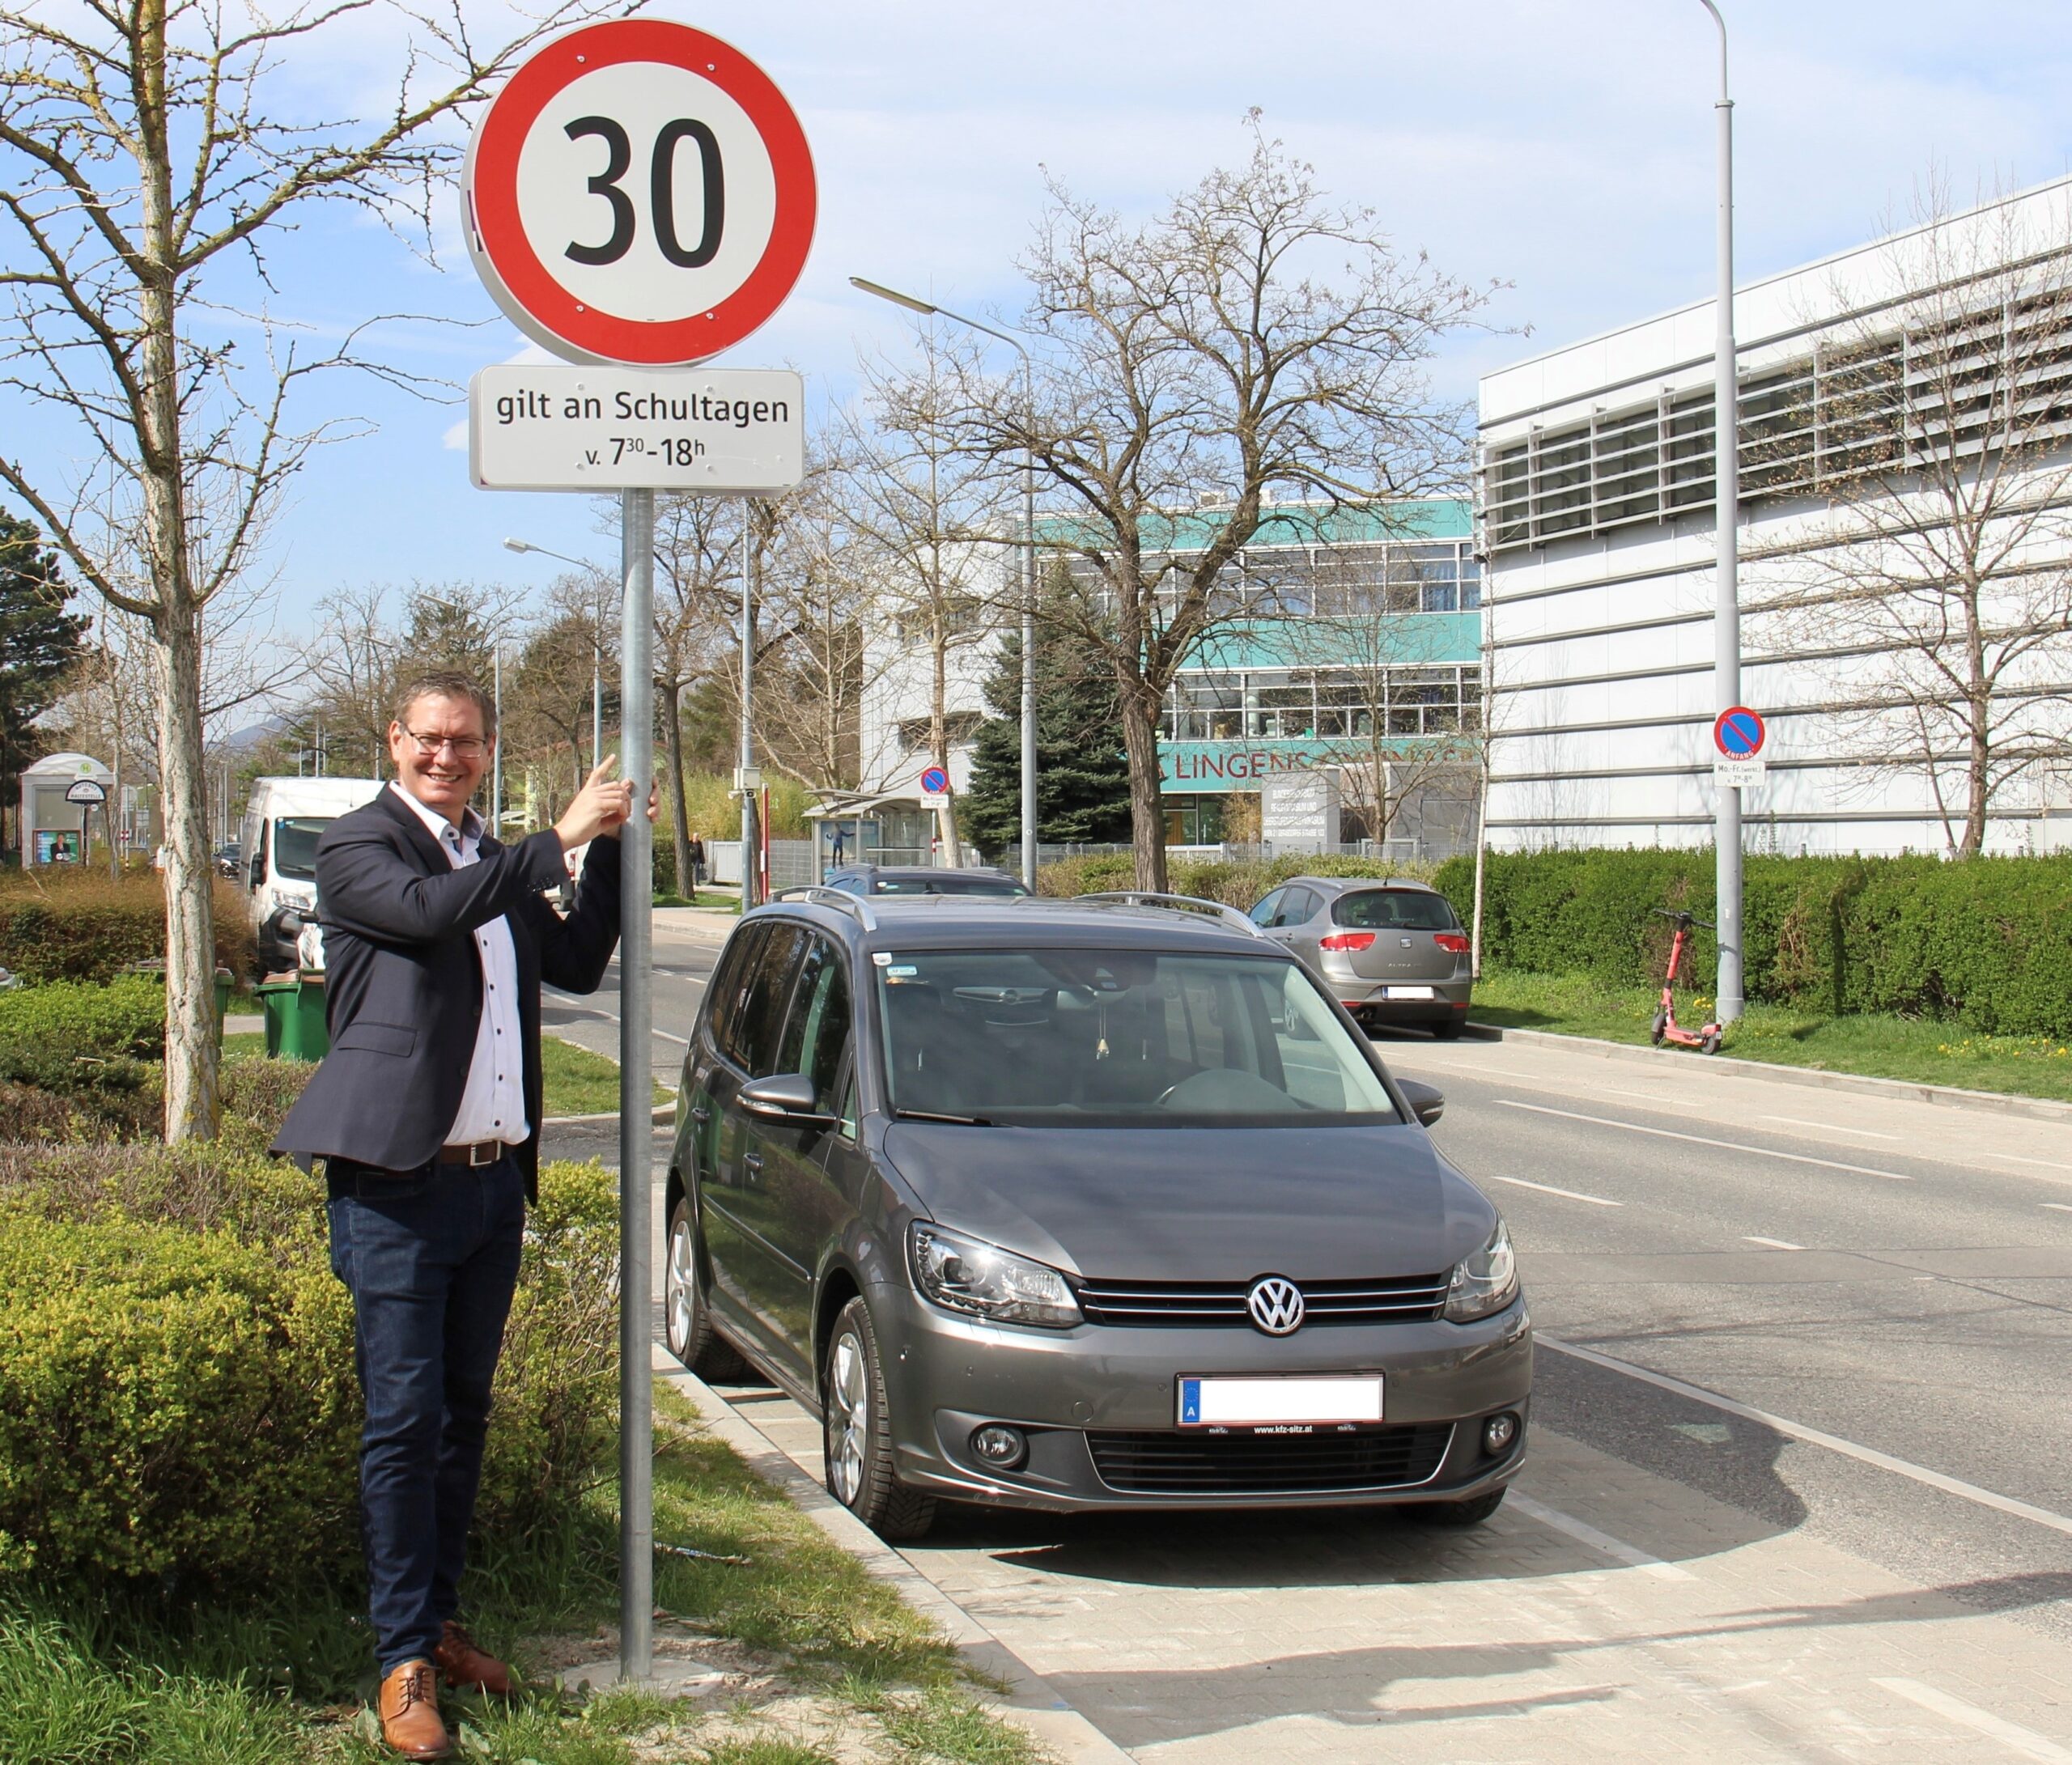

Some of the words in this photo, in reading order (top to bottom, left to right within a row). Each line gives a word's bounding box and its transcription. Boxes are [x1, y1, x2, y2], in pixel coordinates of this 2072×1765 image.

[563, 116, 725, 268] 30
[496, 389, 552, 425] gilt
[564, 394, 601, 419] an
[615, 390, 789, 428] Schultagen
[585, 448, 601, 465] v.
[1726, 750, 1754, 760] ANFANG
[1187, 1406, 1195, 1417] A
[1254, 1425, 1313, 1434] www.kfz-sitz.at
